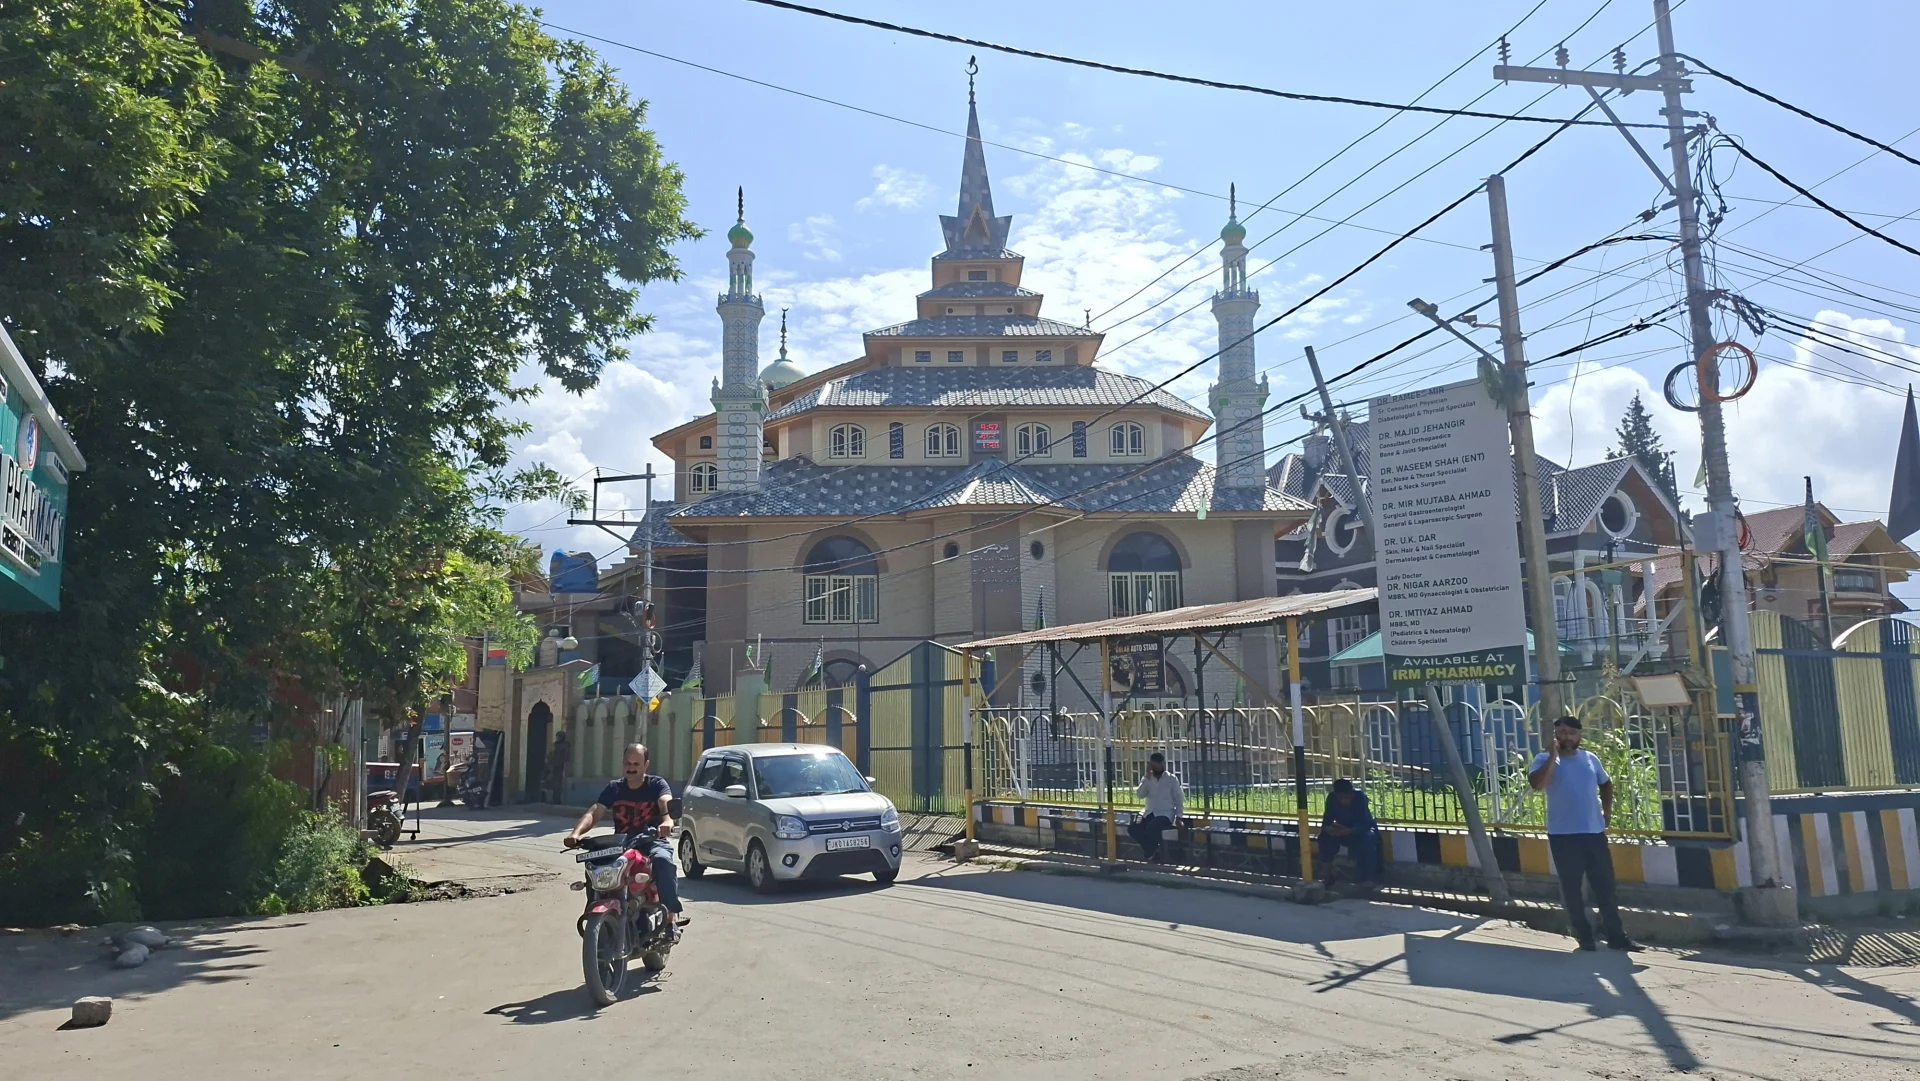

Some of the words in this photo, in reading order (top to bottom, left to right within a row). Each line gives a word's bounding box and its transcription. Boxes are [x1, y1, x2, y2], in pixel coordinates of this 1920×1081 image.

[1429, 387, 1444, 395] MIR
[1387, 402, 1417, 412] Consultant
[1420, 398, 1447, 407] Physician
[1378, 412, 1415, 423] Diabetologist
[1423, 405, 1444, 415] Thyroid
[1446, 402, 1476, 411] Specialist
[1394, 428, 1420, 438] MAJID
[1422, 420, 1465, 433] JEHANGIR
[1379, 440, 1410, 449] Consultant
[1412, 433, 1451, 444] Orthopaedics
[1418, 443, 1447, 452] Specialist
[1396, 462, 1432, 473] WASEEM
[1435, 457, 1459, 466] SHAH
[1462, 453, 1485, 464] (ENT)
[1416, 471, 1435, 479] Throat
[1437, 467, 1466, 477] Specialist
[1421, 479, 1445, 488] Surgeon
[1398, 500, 1413, 508] MIR
[1416, 495, 1457, 505] MUJTABA
[1459, 490, 1491, 500] AHMAD
[5, 458, 64, 561] PHARMACY
[1383, 511, 1407, 519] Surgical
[1409, 505, 1465, 516] Gastroenterologist
[1414, 515, 1455, 525] Laparoscopic
[1456, 511, 1482, 520] Surgeon
[1400, 536, 1416, 544] U.K.
[1419, 534, 1436, 542] DAR
[1435, 542, 1465, 550] Specialist
[1386, 555, 1426, 564] Dermatologist
[1435, 550, 1479, 560] Cosmetologist
[1388, 583, 1400, 591] DR.
[1403, 581, 1429, 589] NIGAR
[1433, 577, 1468, 587] AARZOO
[1420, 589, 1462, 599] Gynaecologist
[1471, 584, 1509, 593] Obstetrician
[1405, 607, 1438, 617] IMTIYAZ
[1441, 605, 1473, 614] AHMAD
[1430, 626, 1471, 635] Neonatology)
[1143, 643, 1158, 651] STAND
[1391, 638, 1416, 646] Children
[1418, 637, 1447, 645] Specialist
[1403, 656, 1479, 666] AVAILABLE
[1486, 653, 1504, 662] AT
[1393, 668, 1421, 680] IRM
[1426, 664, 1516, 678] PHARMACY
